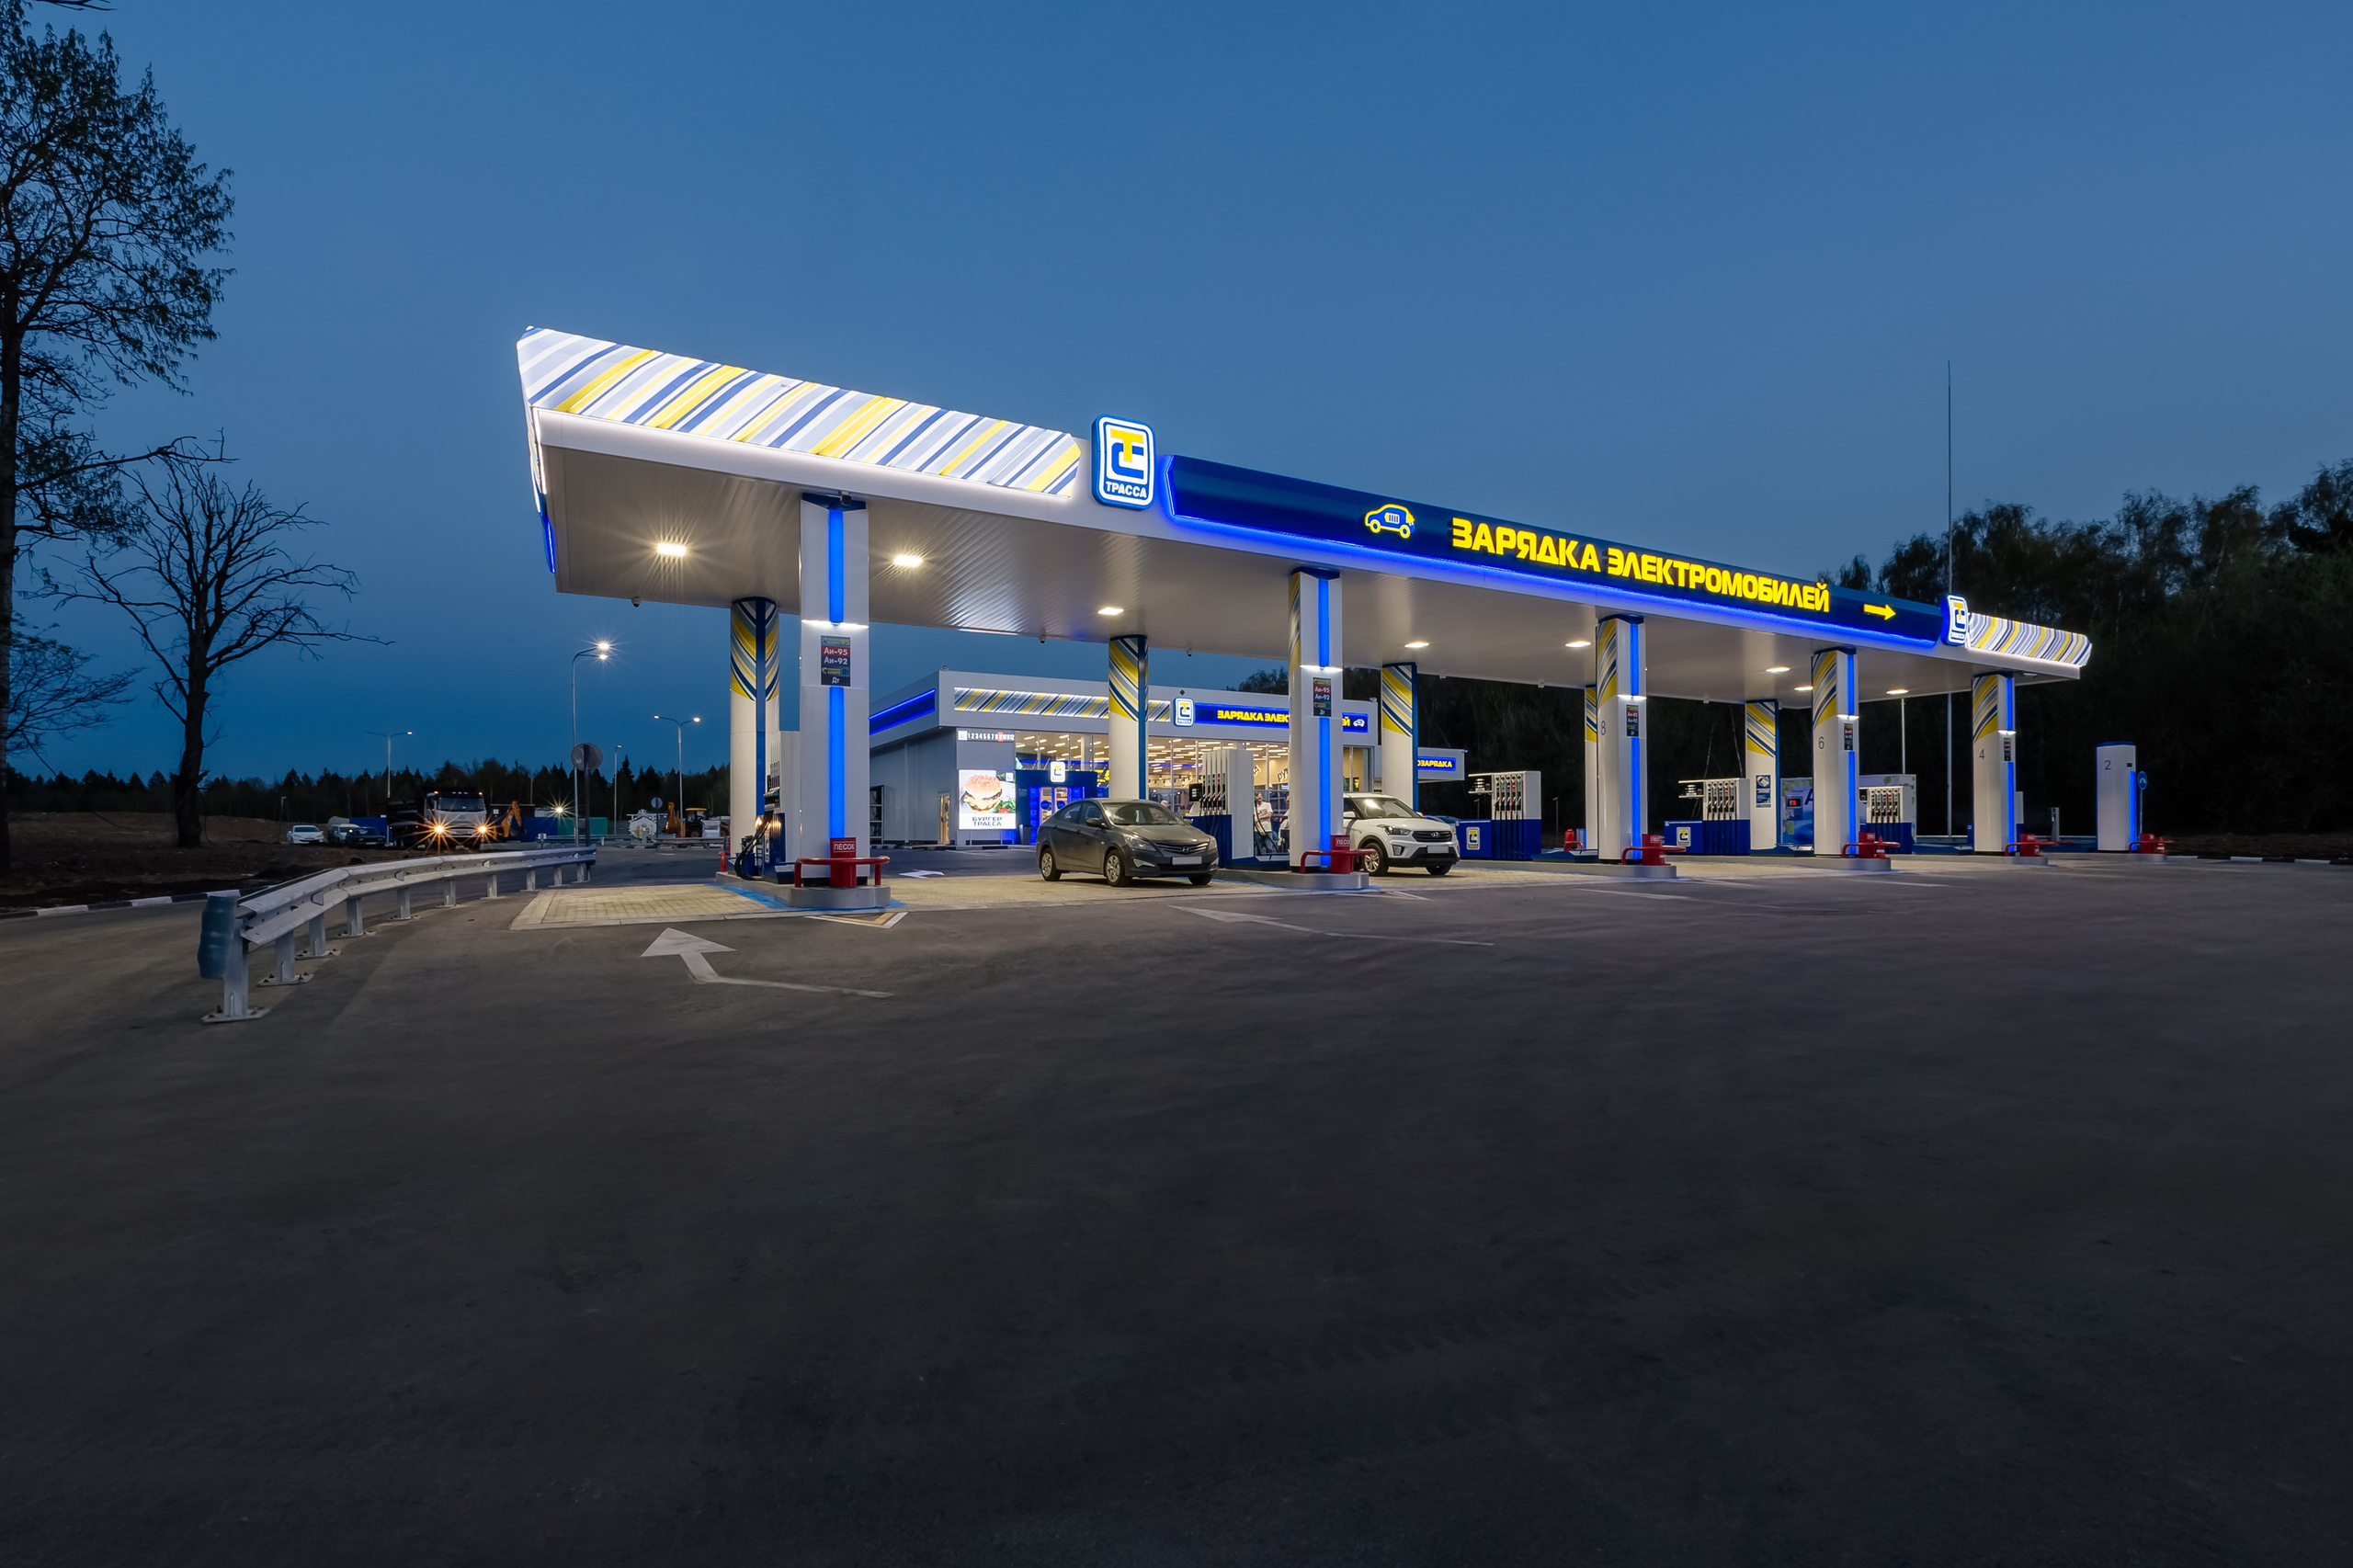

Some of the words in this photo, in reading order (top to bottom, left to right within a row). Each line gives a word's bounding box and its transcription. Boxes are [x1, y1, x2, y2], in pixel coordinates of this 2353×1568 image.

[1105, 481, 1147, 498] ТРАССА
[1452, 517, 1601, 573] ЗАРЯДКА
[1608, 547, 1830, 613] ЭЛЕКТРОМОБИЛЕЙ
[824, 646, 848, 656] Аи-95
[824, 656, 848, 665] Аи-92
[1217, 710, 1265, 722] ЗАРЯДКА
[1600, 721, 1607, 735] 8
[1818, 736, 1824, 750] 6
[1978, 748, 1985, 761] 4
[2104, 759, 2111, 770] 2
